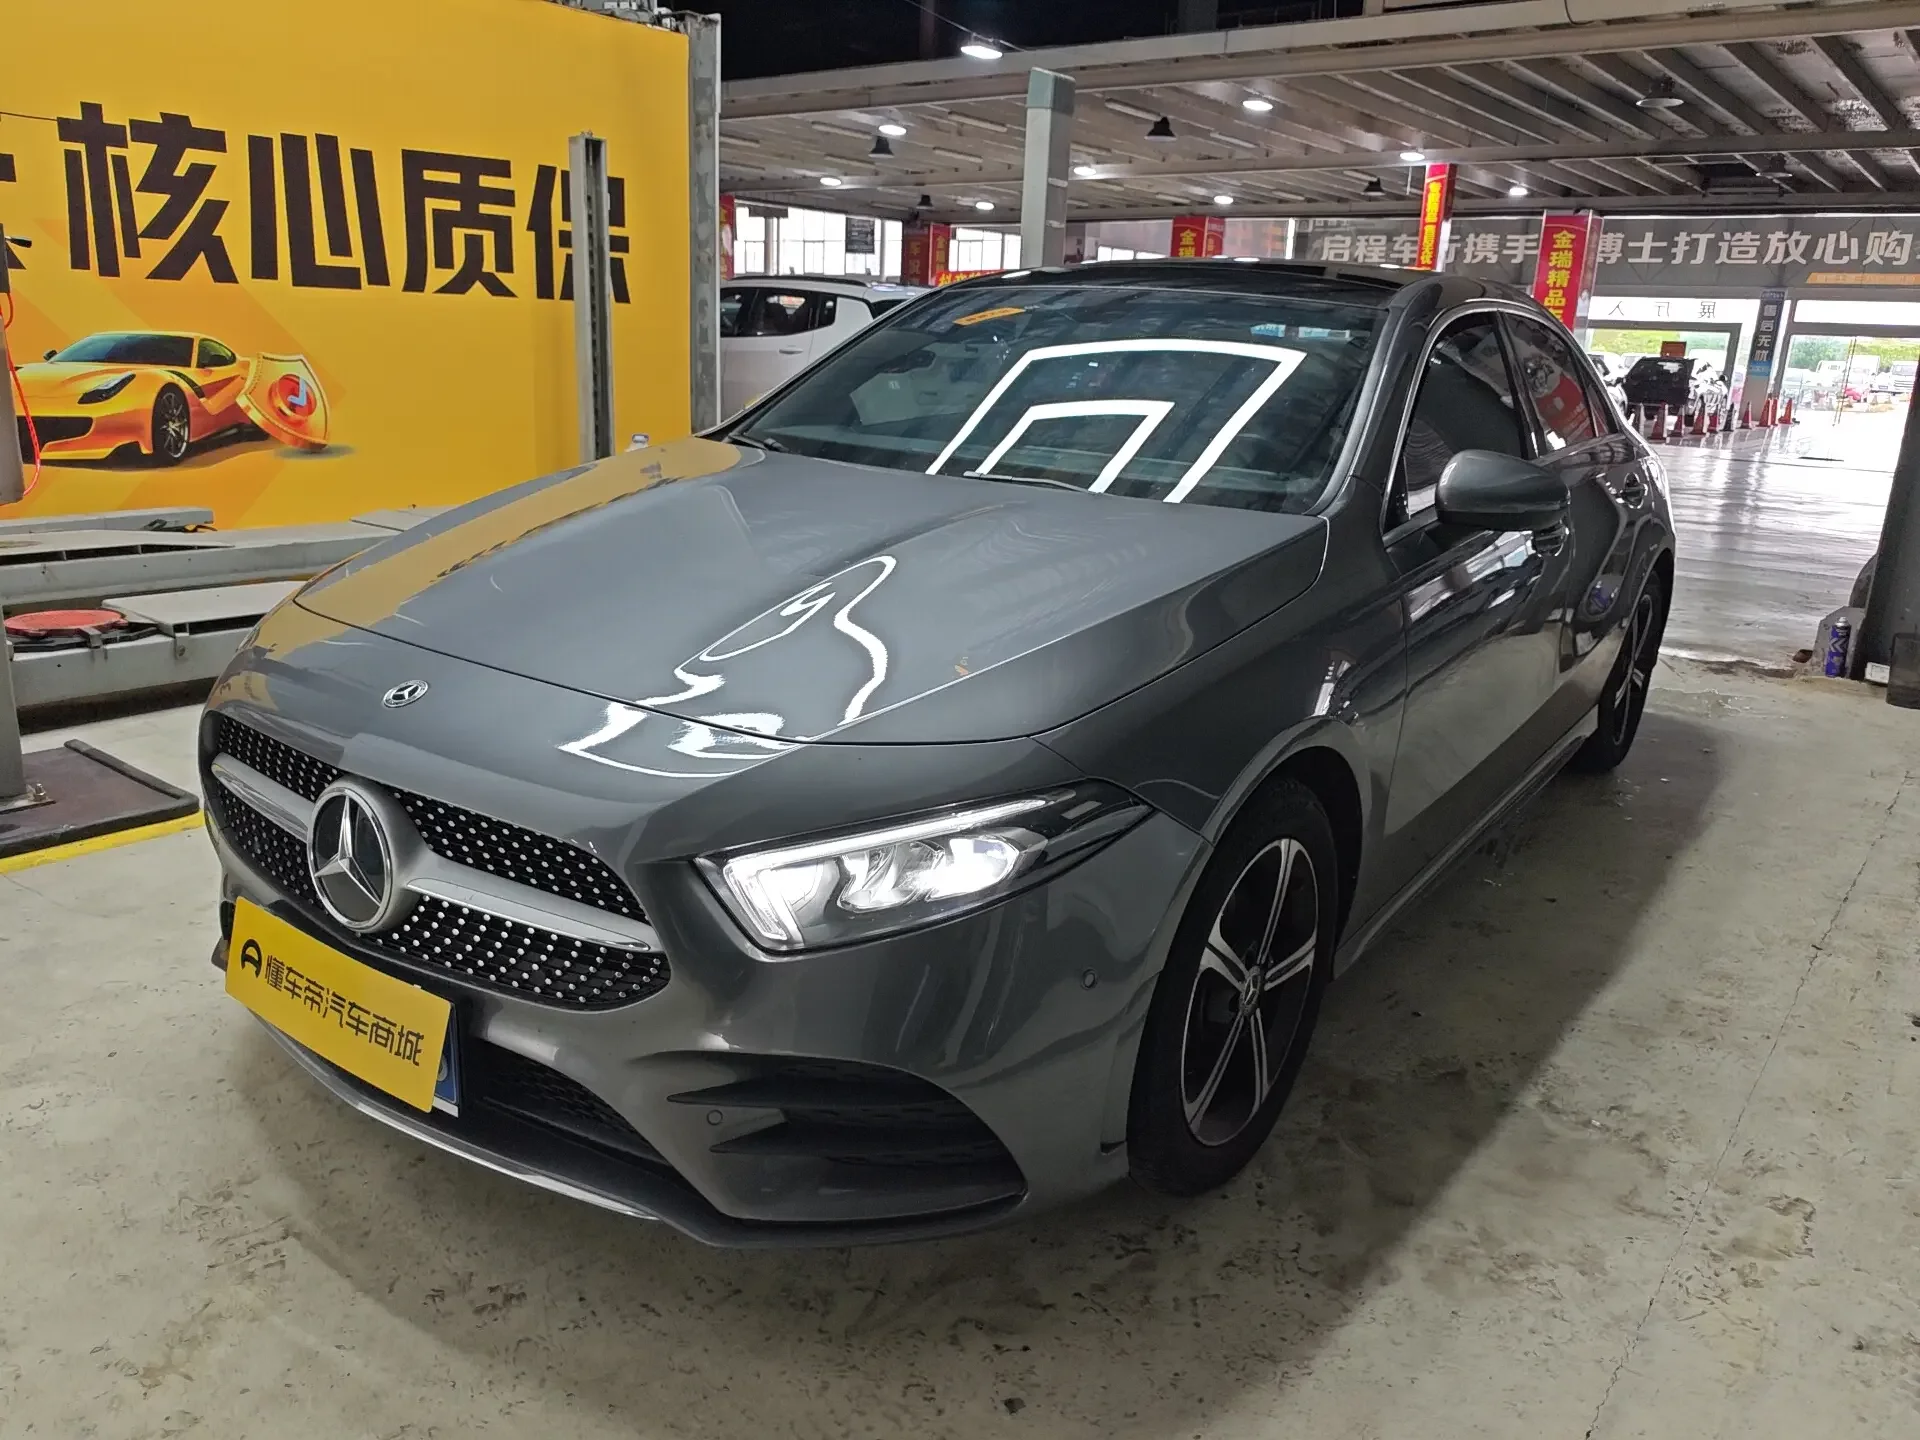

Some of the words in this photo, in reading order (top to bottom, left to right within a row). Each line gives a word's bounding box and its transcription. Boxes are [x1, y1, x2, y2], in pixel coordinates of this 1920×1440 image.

[0, 101, 631, 304] 核心质保
[264, 954, 425, 1067] 懂车帝汽车商城
